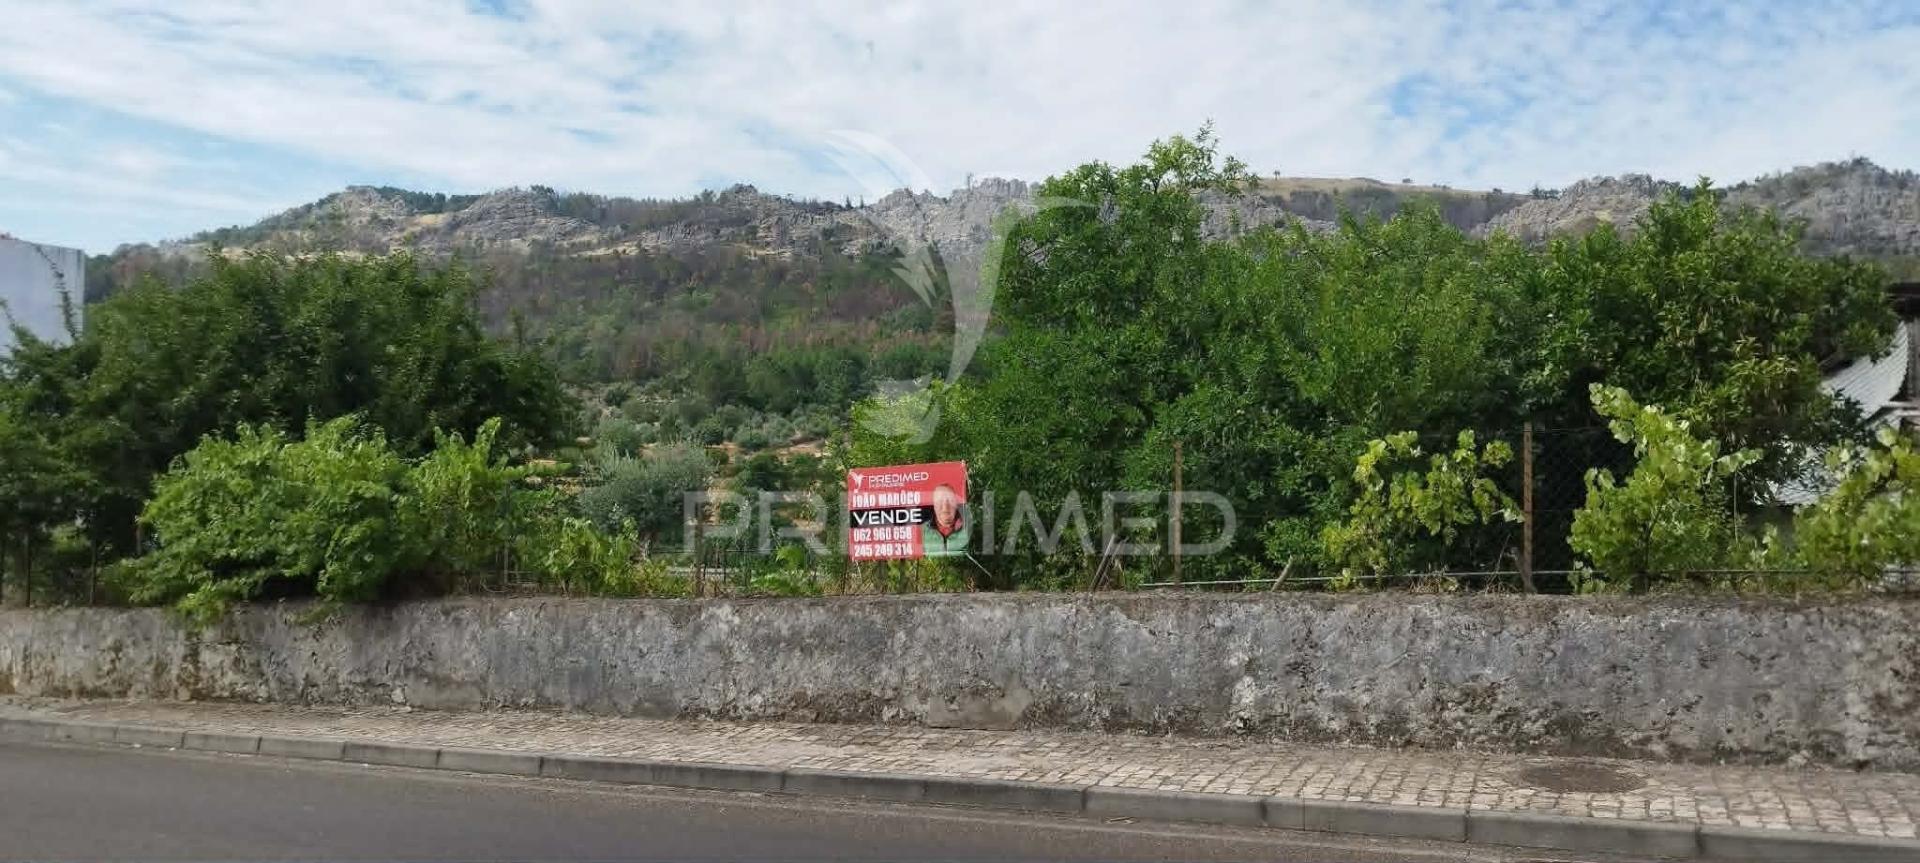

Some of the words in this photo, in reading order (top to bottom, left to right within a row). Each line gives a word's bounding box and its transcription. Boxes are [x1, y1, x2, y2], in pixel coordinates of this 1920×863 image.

[868, 472, 929, 484] PREDIMED
[853, 508, 922, 525] VENDE
[854, 543, 873, 557] 245
